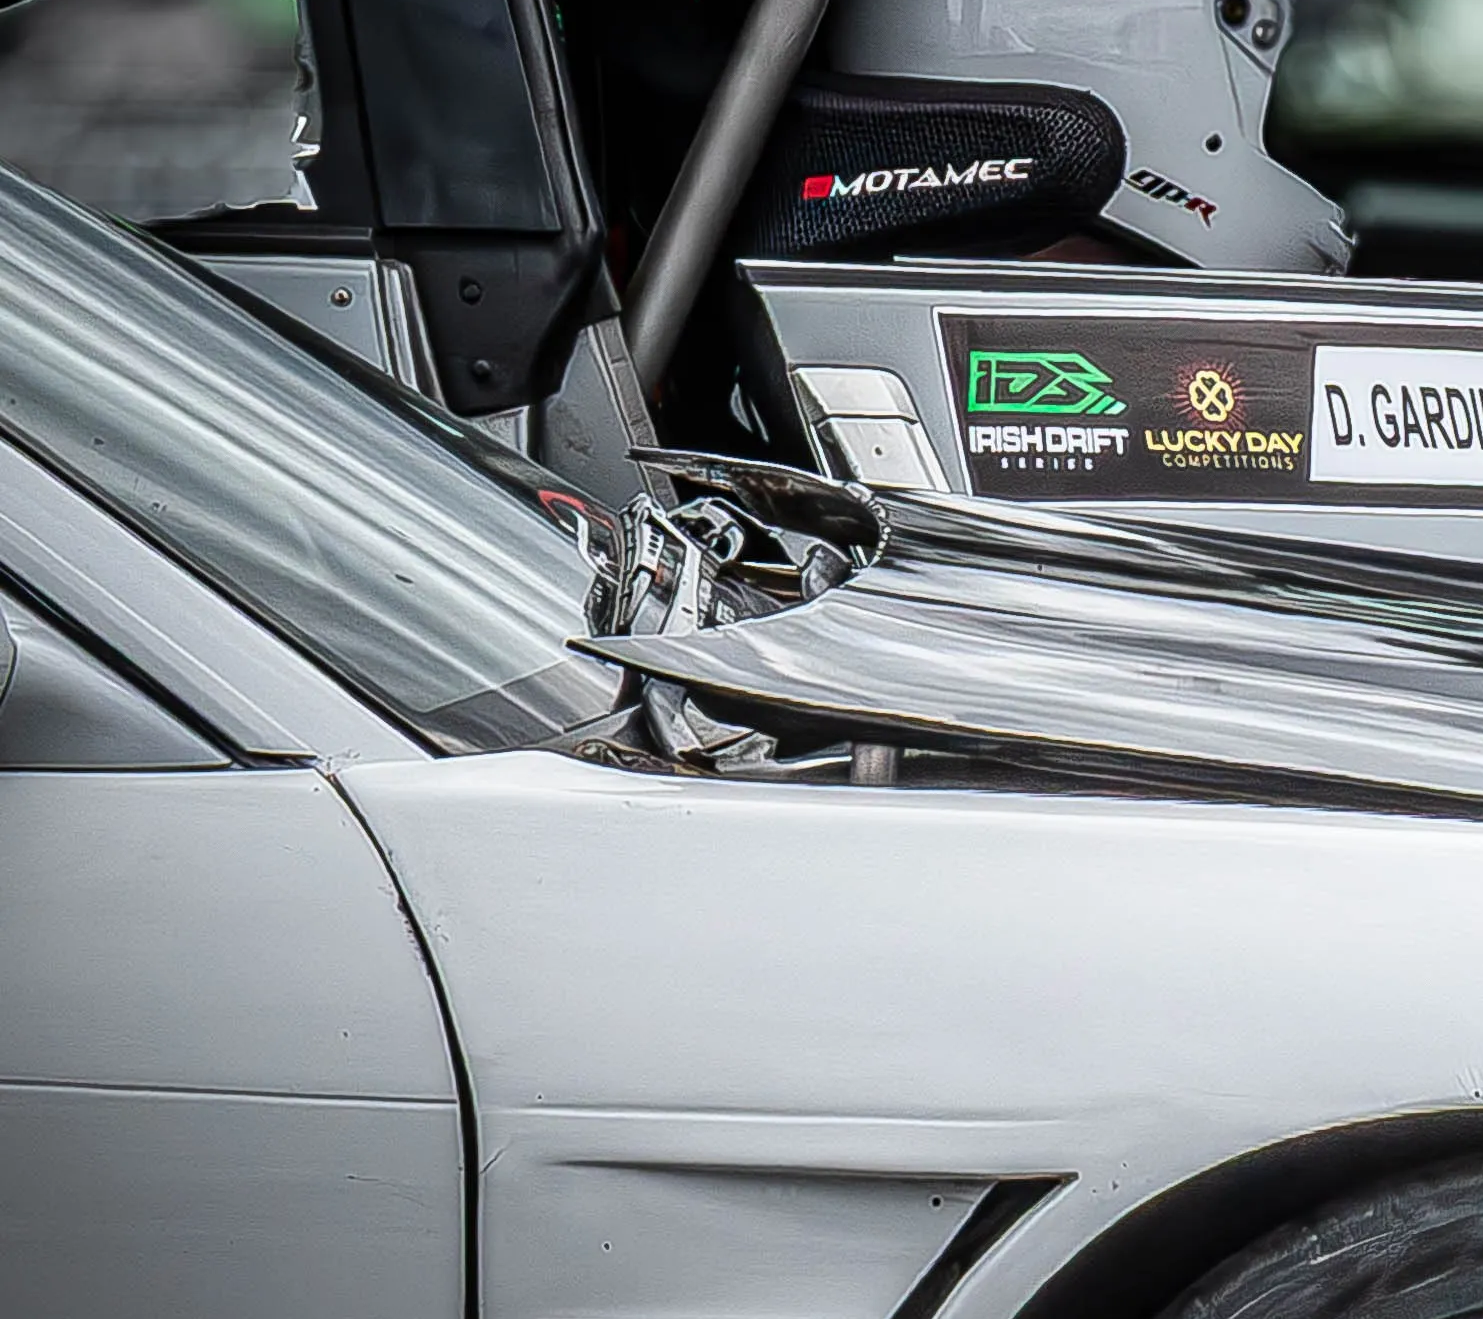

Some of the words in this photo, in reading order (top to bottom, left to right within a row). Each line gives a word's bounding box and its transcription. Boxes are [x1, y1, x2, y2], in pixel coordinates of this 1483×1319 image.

[831, 157, 1034, 198] MOTAMEC
[1324, 383, 1366, 447] D.
[968, 425, 1045, 454] IRISH
[1046, 427, 1129, 456] DRIFT
[1144, 430, 1244, 454] LUCKY
[1246, 431, 1304, 455] DAY
[1162, 454, 1294, 471] COMPETITIONS
